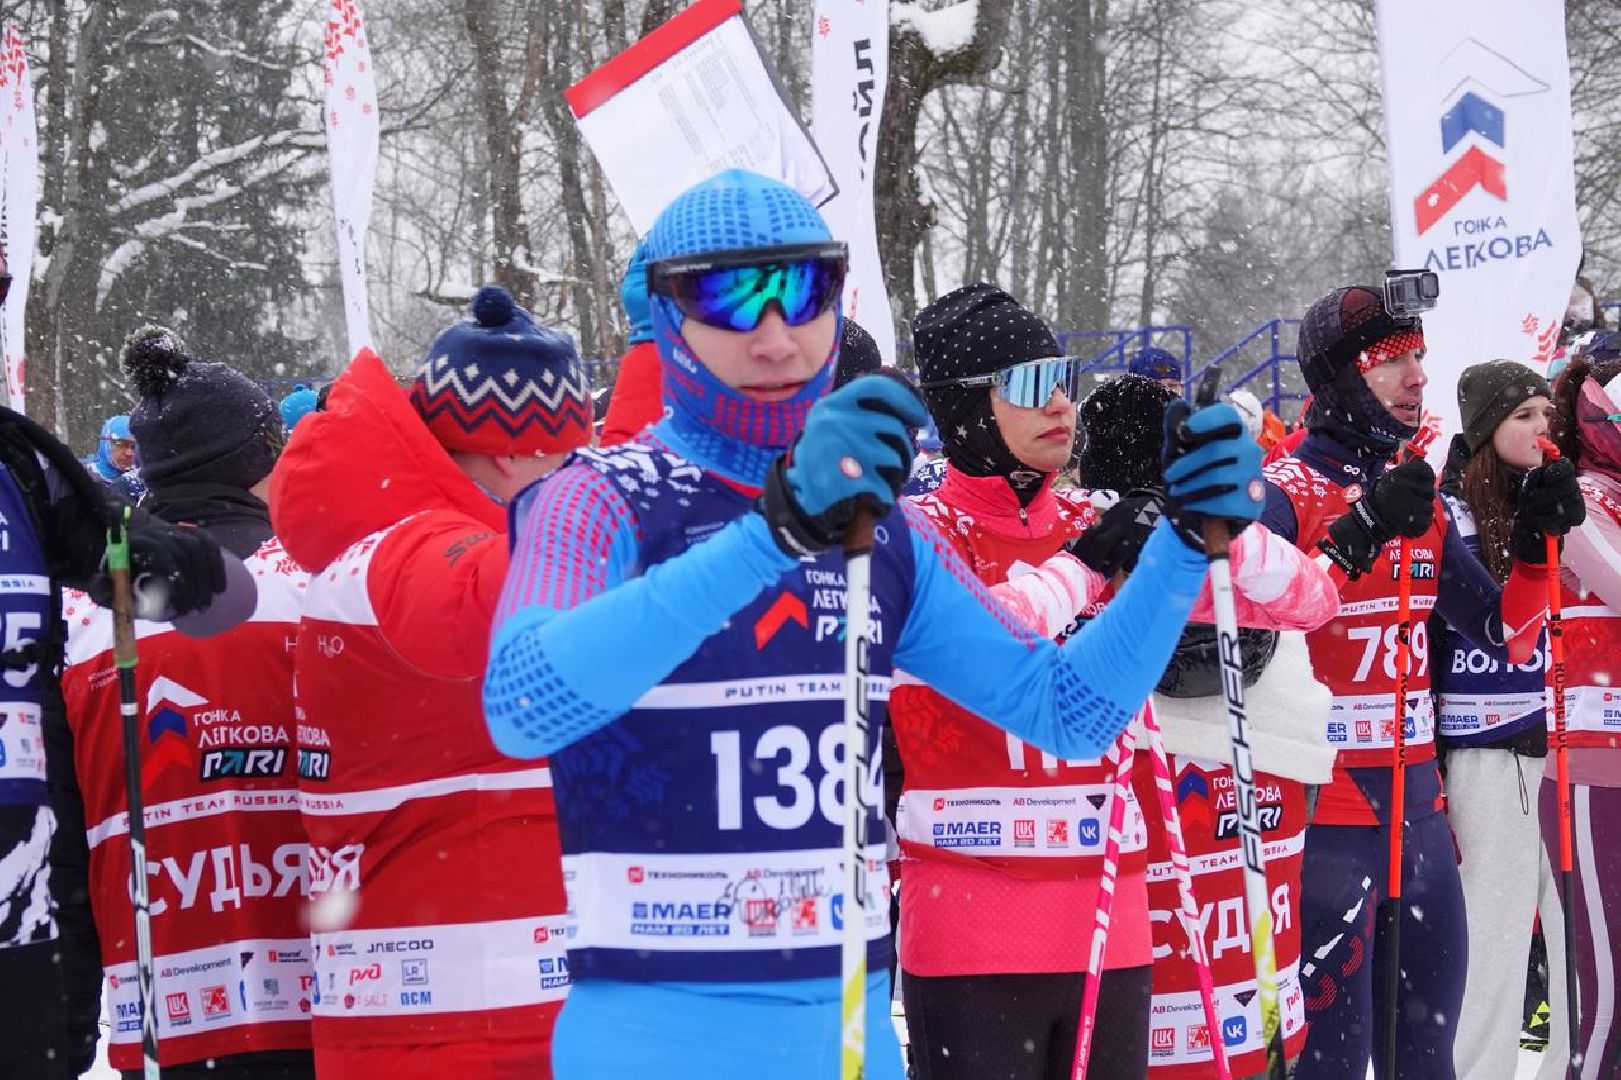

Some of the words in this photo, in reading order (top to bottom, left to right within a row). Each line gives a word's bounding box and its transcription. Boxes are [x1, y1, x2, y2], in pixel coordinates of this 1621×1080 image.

[1424, 227, 1552, 271] ЛЕГКОВА
[1342, 603, 1376, 613] PUTIN
[0, 611, 41, 689] 5
[1348, 621, 1429, 682] 789
[725, 683, 787, 698] PUTIN
[799, 682, 841, 693] TEAM
[193, 709, 242, 726] ГОНКА
[198, 725, 289, 748] ЛЕГКОВА
[1221, 632, 1265, 876] FISCHER
[710, 723, 886, 832] 1384
[234, 795, 299, 805] RUSSIA
[1013, 797, 1025, 807] AB
[1027, 797, 1076, 807] Development
[1216, 786, 1282, 809] ЛЕОВА
[947, 821, 1002, 836] MAER
[1200, 854, 1239, 868] TEAM
[128, 843, 312, 916] СУДЬЯ
[652, 903, 732, 920] MAER
[1149, 882, 1292, 962] СУДЯ
[173, 958, 232, 976] Development
[1152, 1006, 1166, 1014] AB
[1153, 1029, 1174, 1049] LUK
[1227, 1024, 1243, 1038] VK
